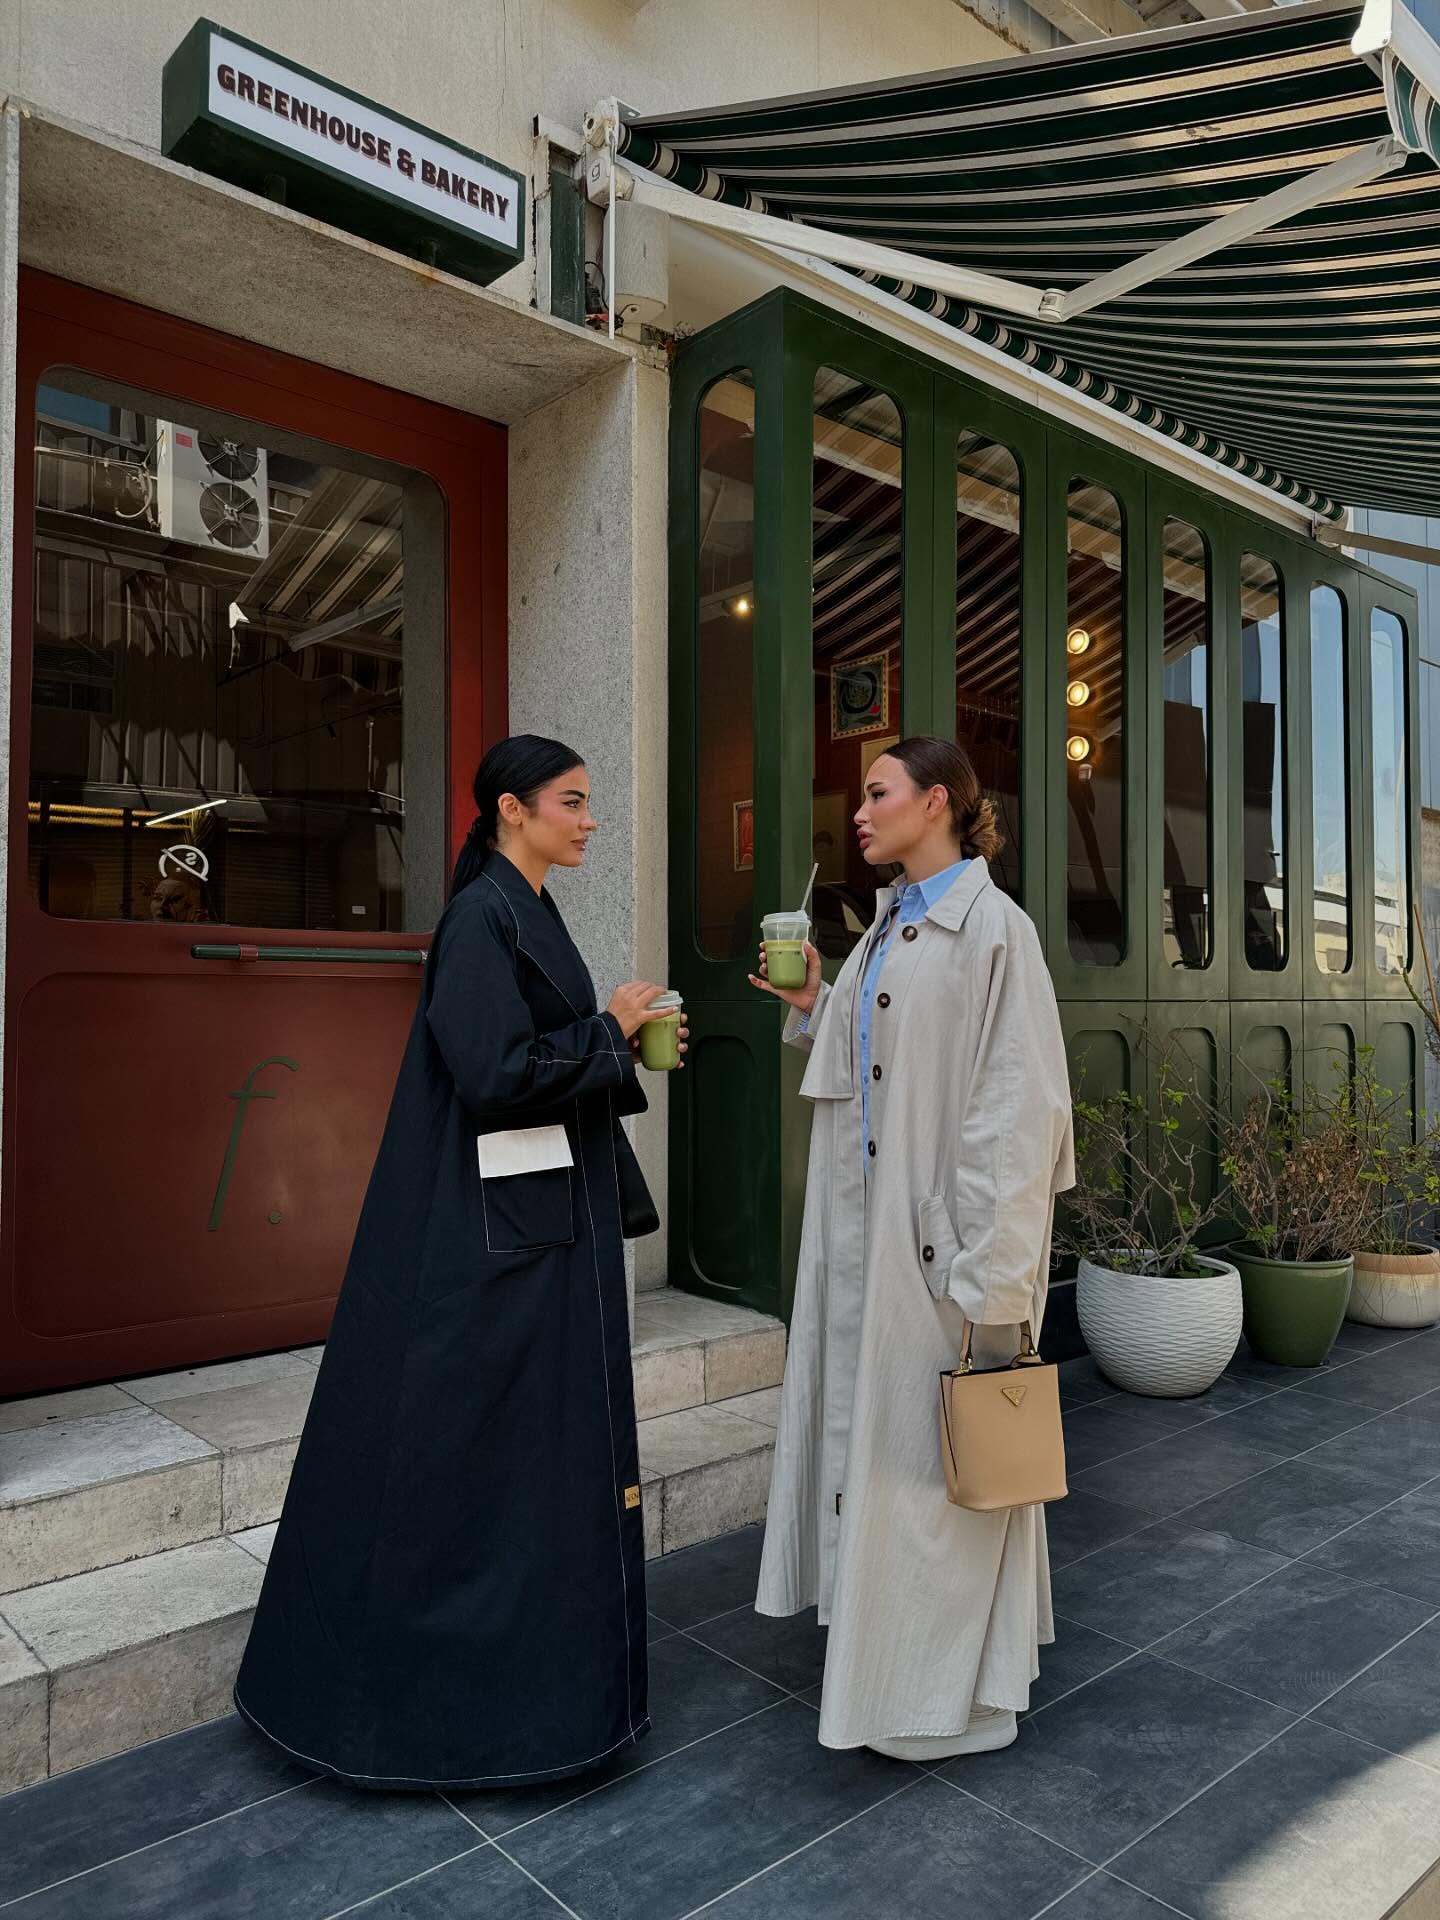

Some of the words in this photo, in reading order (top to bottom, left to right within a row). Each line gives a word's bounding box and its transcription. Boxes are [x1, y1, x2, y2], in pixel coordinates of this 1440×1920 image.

[216, 63, 392, 169] GREENHOUSE
[396, 147, 417, 182] &
[421, 158, 510, 222] BAKERY
